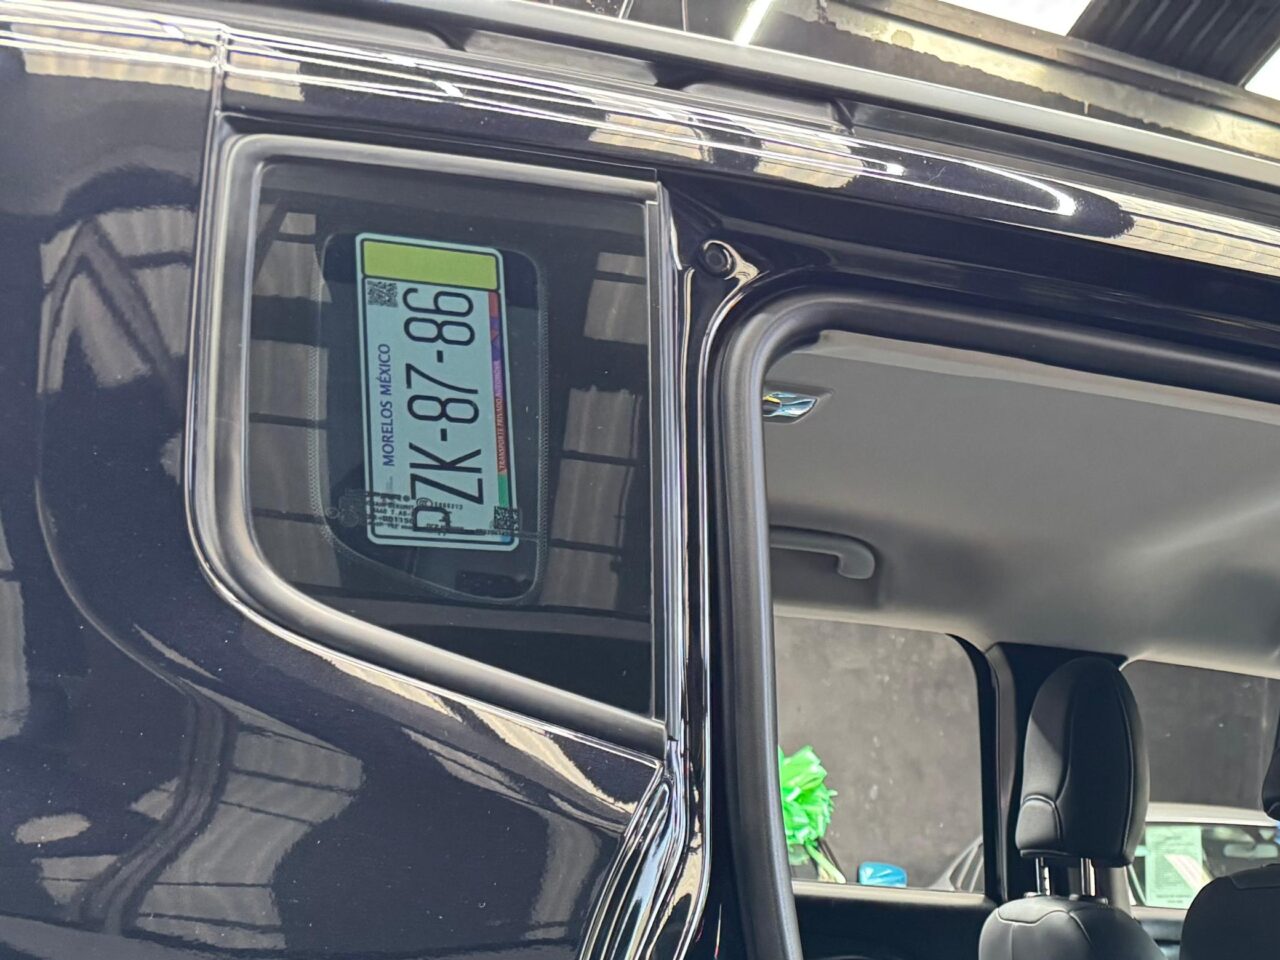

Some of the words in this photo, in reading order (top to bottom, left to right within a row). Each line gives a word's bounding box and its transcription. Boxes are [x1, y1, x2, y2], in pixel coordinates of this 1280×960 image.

[376, 343, 393, 396] MÉXICO
[380, 400, 395, 467] MORELOS
[402, 287, 486, 536] PZK-87-86
